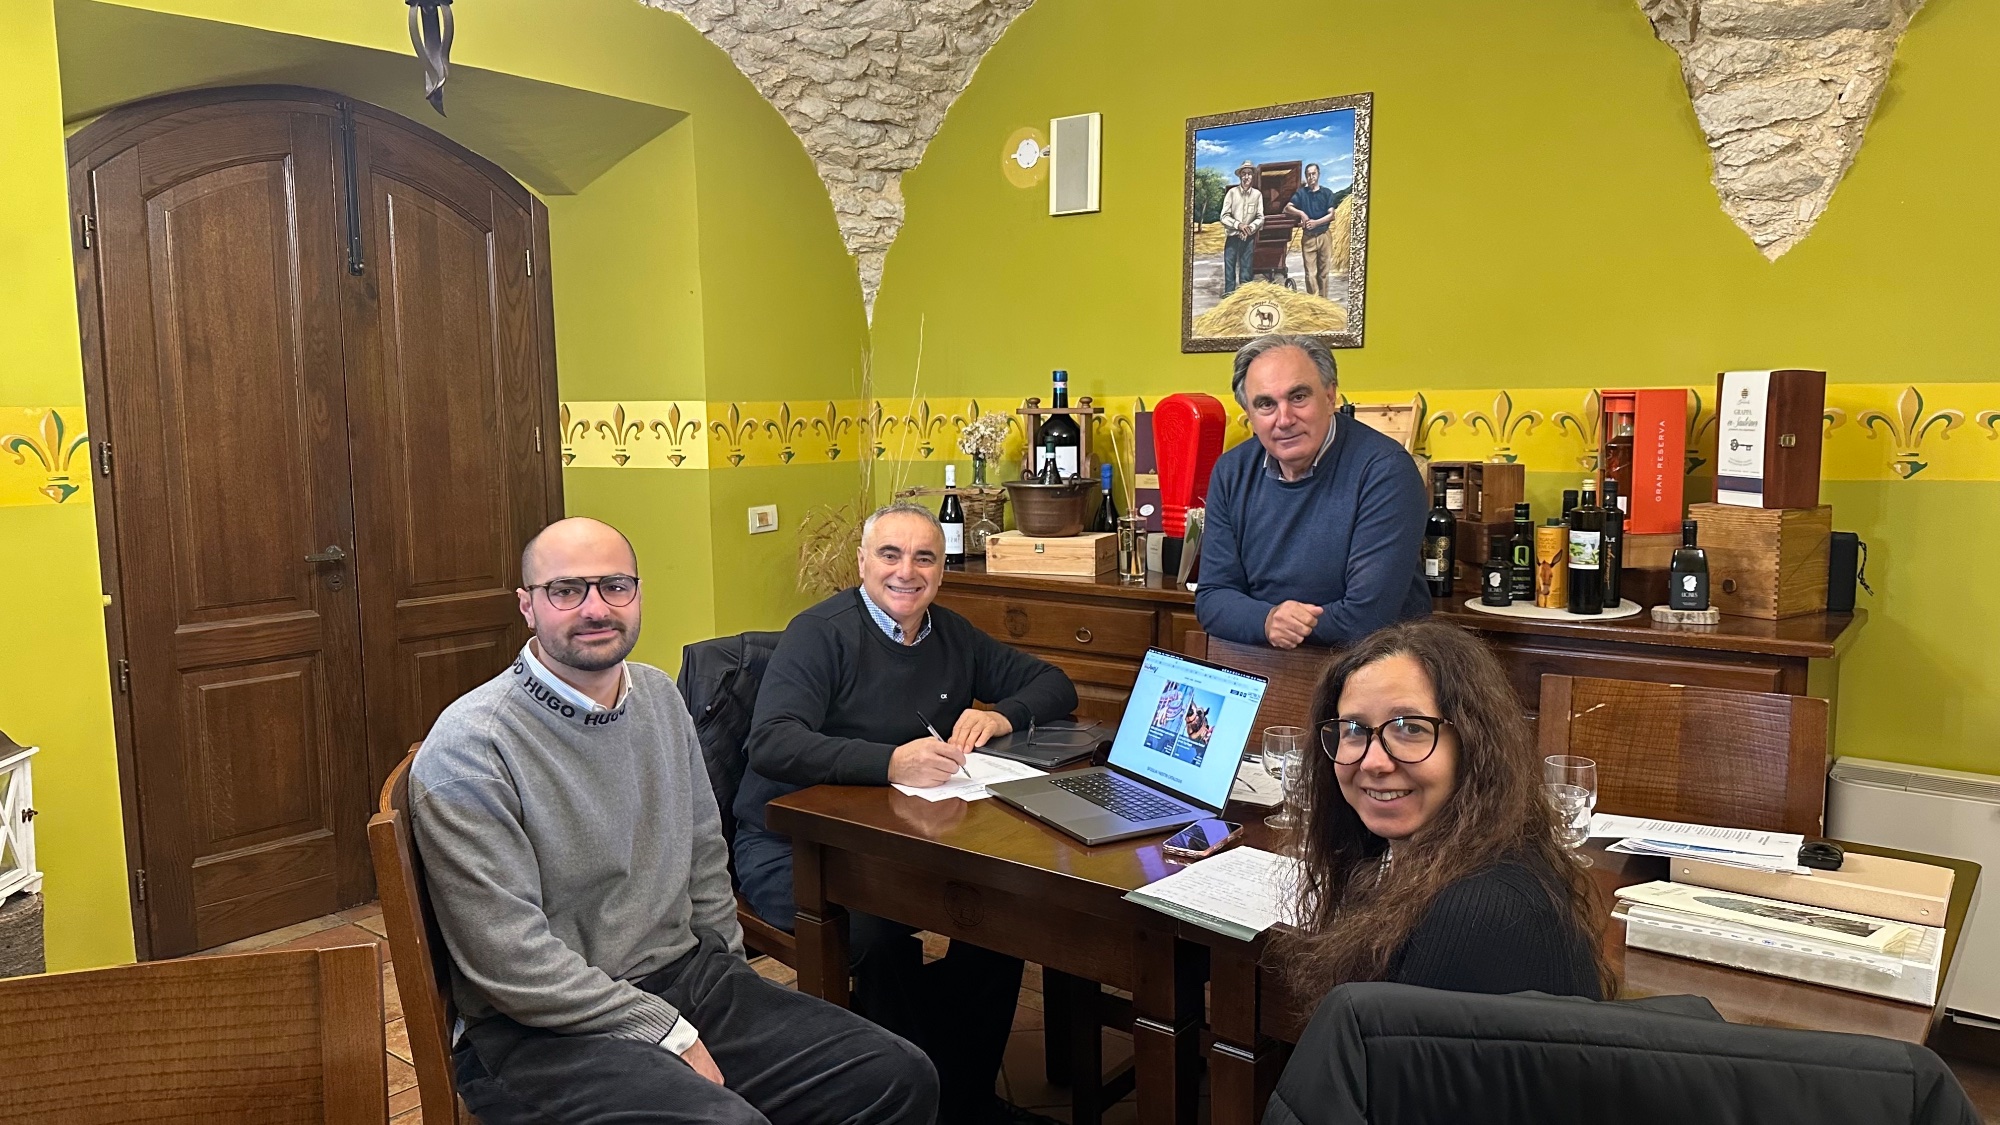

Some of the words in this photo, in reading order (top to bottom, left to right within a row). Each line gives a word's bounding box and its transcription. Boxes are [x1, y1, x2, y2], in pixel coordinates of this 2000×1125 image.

[1657, 420, 1665, 469] RESERVA
[1655, 474, 1663, 502] GRAN
[1514, 545, 1530, 567] Q
[523, 676, 576, 718] HUGO
